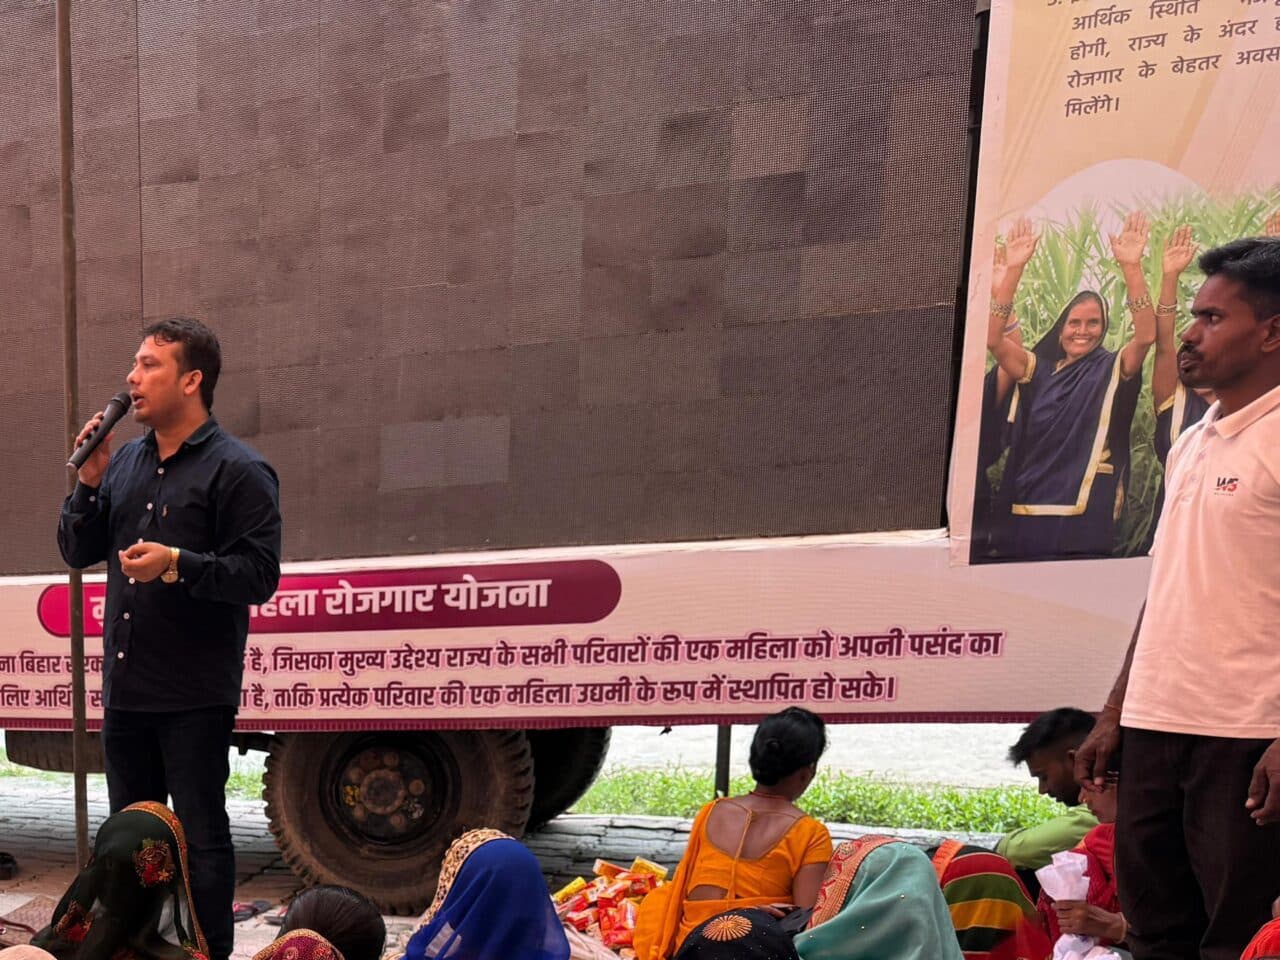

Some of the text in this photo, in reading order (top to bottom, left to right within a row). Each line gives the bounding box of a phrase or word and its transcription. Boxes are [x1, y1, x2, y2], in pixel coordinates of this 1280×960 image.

[1072, 4, 1133, 30] आर्थिक
[1069, 37, 1110, 60] होगी,
[1128, 33, 1168, 51] राज्य
[1183, 25, 1203, 43] के
[1218, 20, 1259, 38] अंदर
[1067, 68, 1125, 88] रोजगार
[1138, 60, 1157, 78] के
[1171, 54, 1222, 74] बेहतर
[1064, 94, 1120, 118] मिलेंगे।
[322, 579, 437, 615] रोजगार
[441, 574, 552, 611] योजना
[19, 651, 62, 673] बिहार
[250, 647, 267, 674] है,
[272, 647, 334, 671] जिसका
[337, 650, 386, 676] मुख्य
[389, 643, 442, 670] उद्देश्य
[445, 647, 493, 667] राज्य
[496, 641, 517, 666] के
[520, 638, 568, 665] सभी
[571, 636, 651, 664] परिवारों
[652, 635, 682, 662] की
[685, 640, 721, 660] एक
[725, 632, 799, 660] महिला
[802, 630, 834, 658] को
[839, 627, 905, 657] अपनी
[908, 627, 965, 656] पसंद
[969, 632, 1003, 655] का
[0, 684, 30, 707] लिए
[251, 683, 269, 710] है,
[273, 683, 315, 707] ताकि
[318, 682, 370, 707] प्रत्येक
[372, 681, 436, 706] परिवार
[440, 680, 466, 705] की
[469, 685, 503, 705] एक
[505, 678, 572, 703] महिला
[576, 676, 632, 703] उद्यमी
[636, 676, 658, 702] के
[661, 681, 697, 701] रूप
[701, 674, 727, 700] में
[727, 673, 807, 700] स्थापित
[811, 672, 836, 699] हो
[839, 671, 894, 699] सके।
